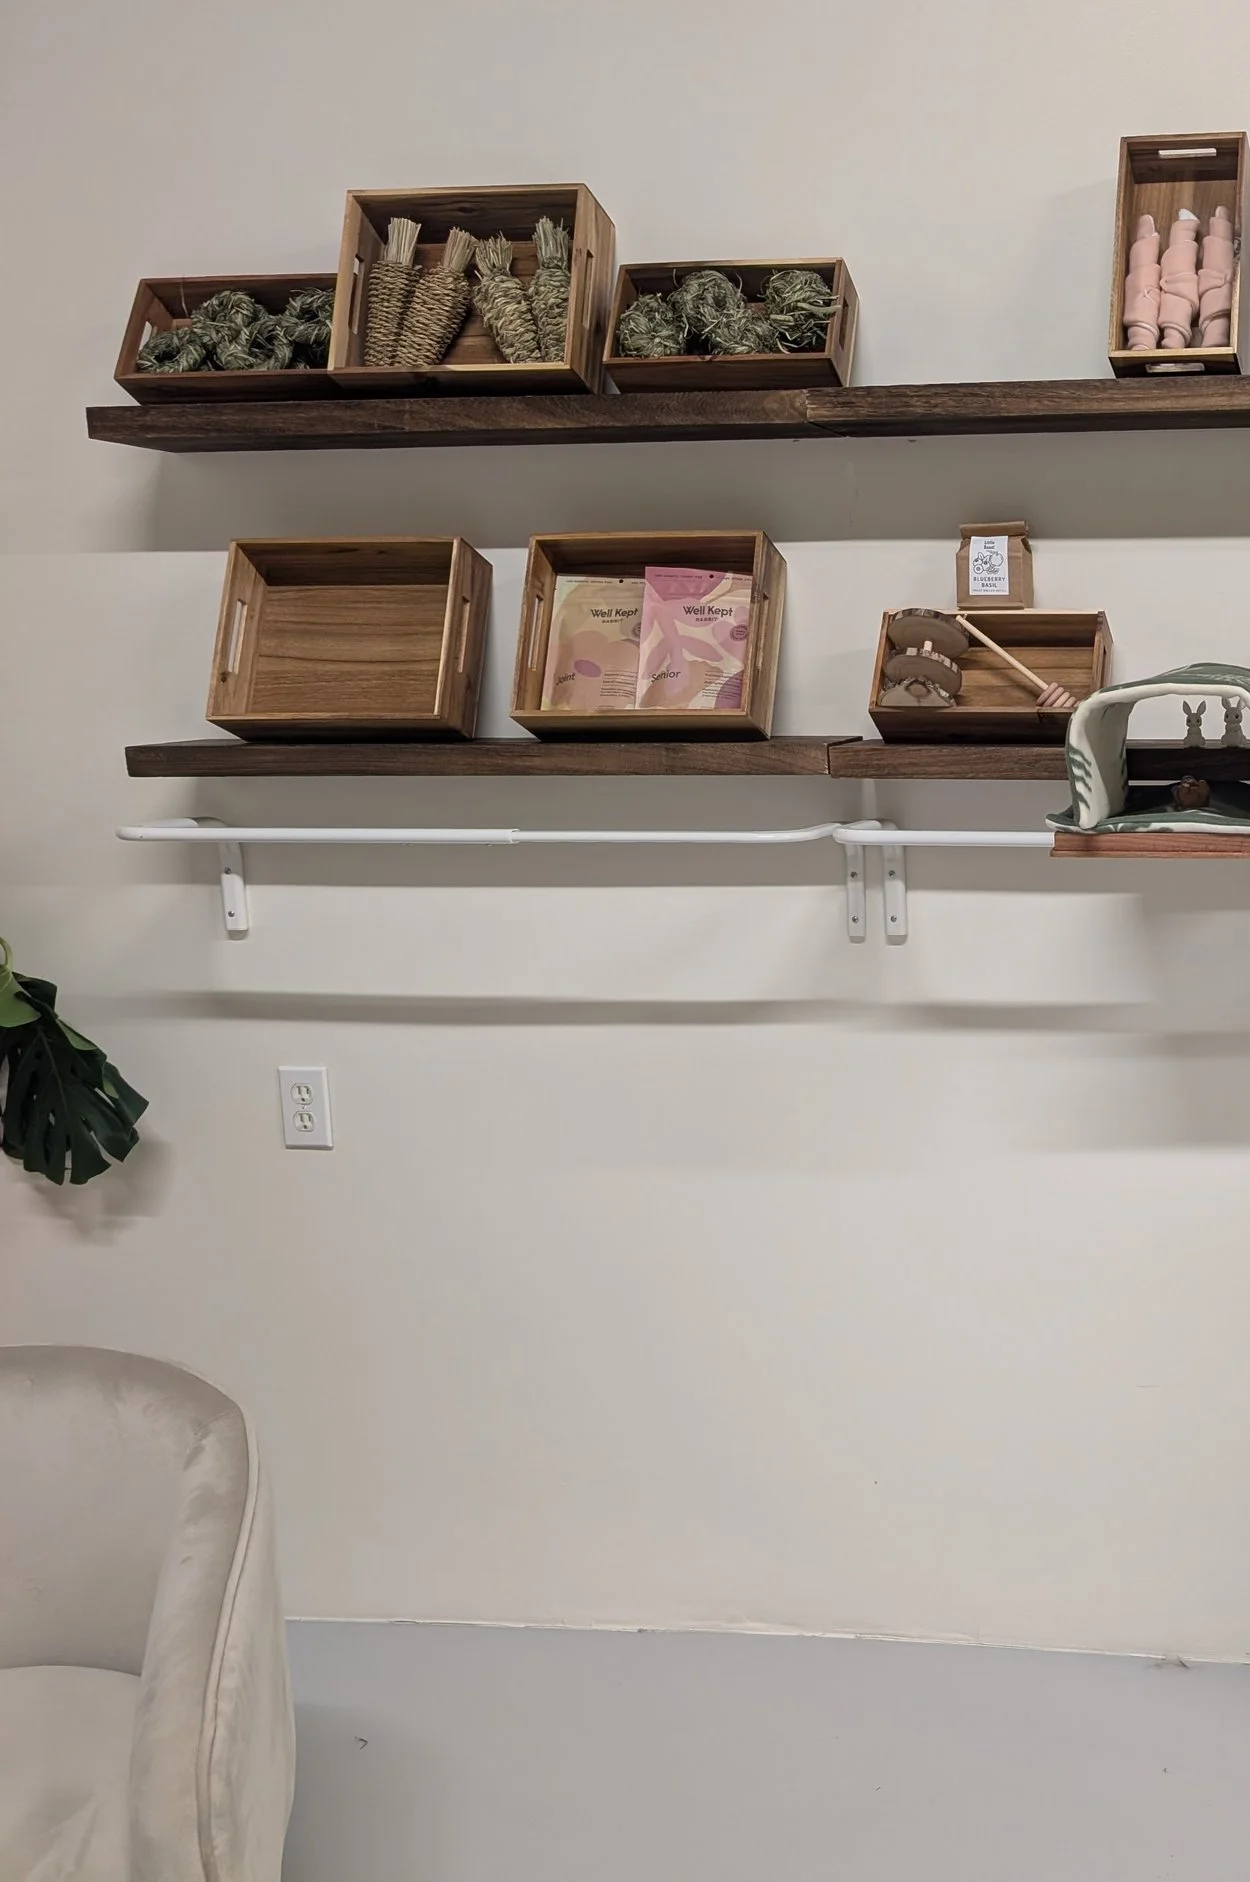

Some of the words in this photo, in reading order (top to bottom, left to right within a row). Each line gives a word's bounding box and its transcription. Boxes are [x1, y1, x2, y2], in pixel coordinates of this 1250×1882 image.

[590, 608, 613, 618] Well
[614, 607, 639, 619] Kept
[682, 605, 706, 616] Well
[707, 605, 734, 618] Kept
[650, 669, 682, 684] Senior
